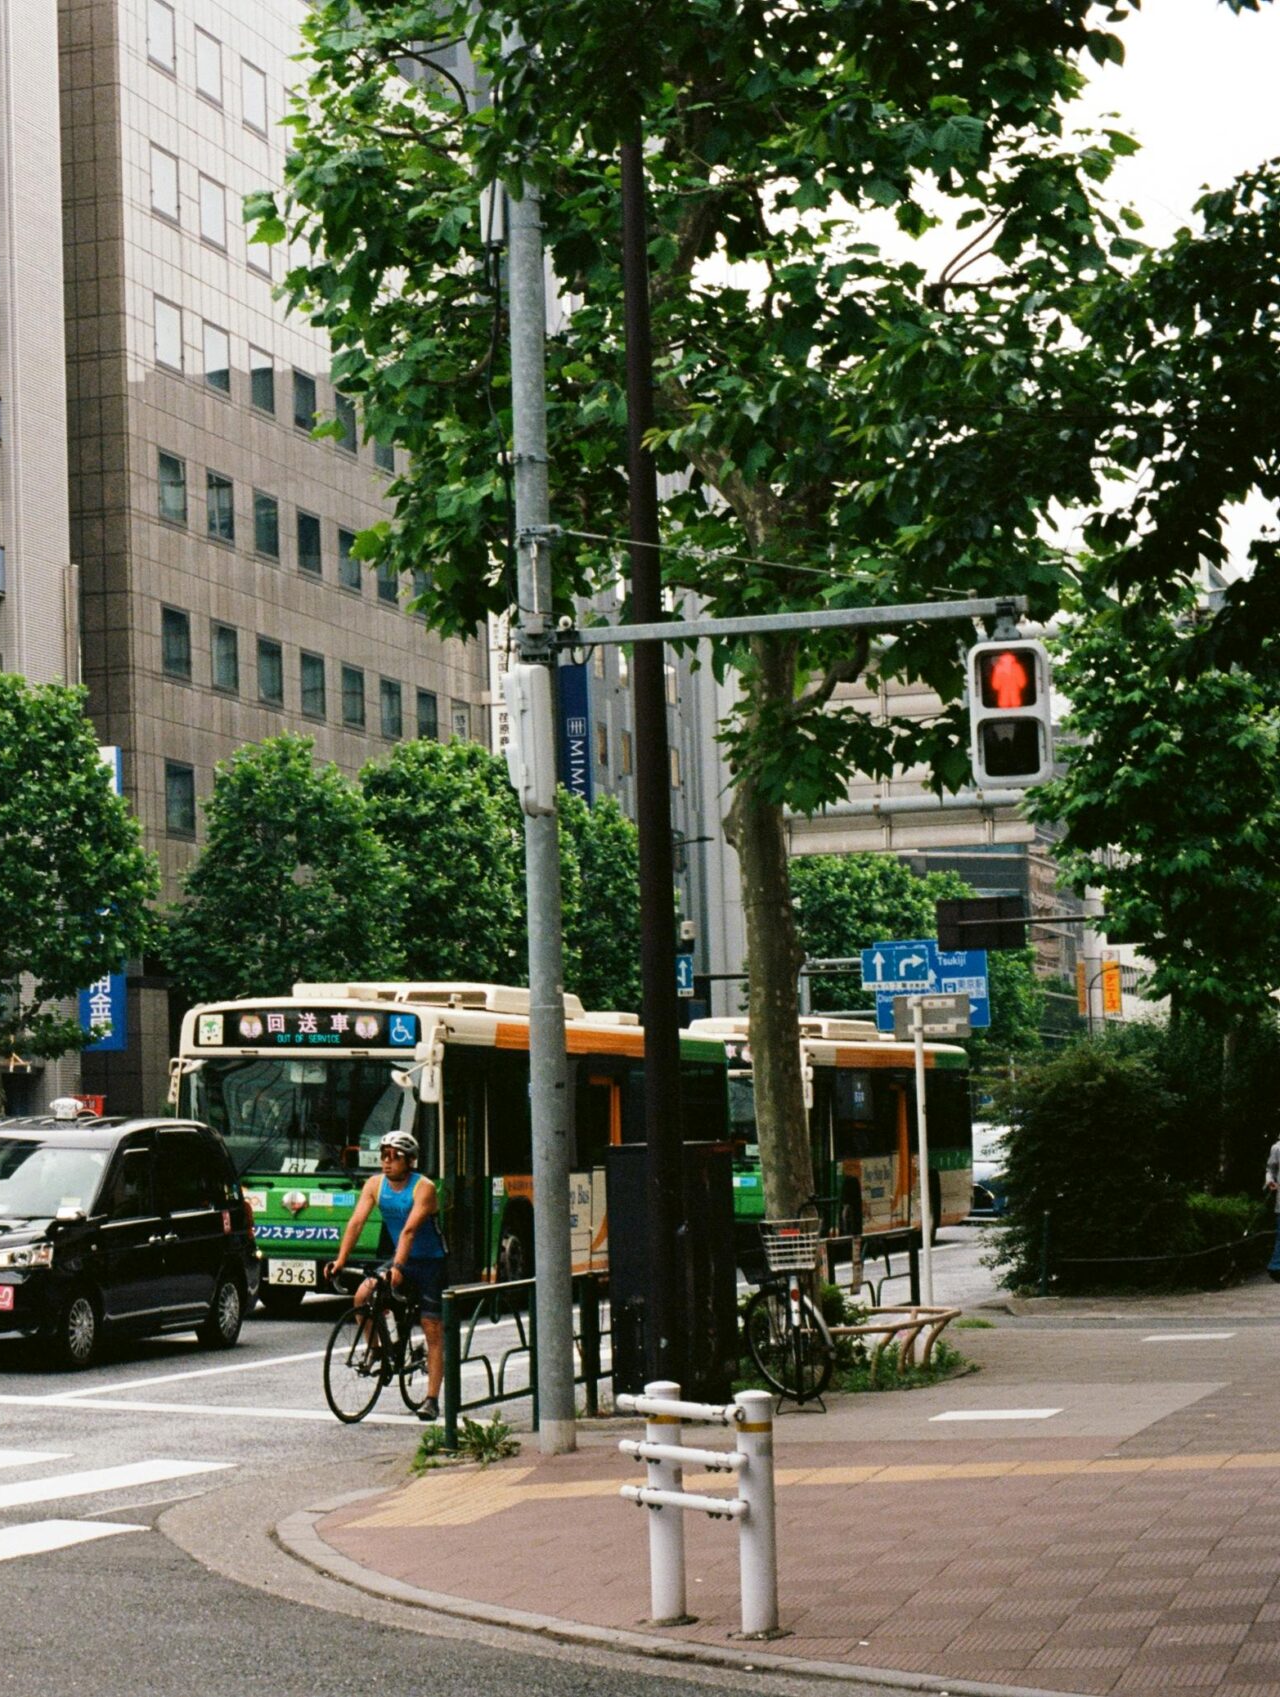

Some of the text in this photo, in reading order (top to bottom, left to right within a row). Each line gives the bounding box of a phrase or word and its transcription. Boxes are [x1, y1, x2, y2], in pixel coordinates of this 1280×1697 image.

[937, 956, 967, 968] Tsukiji
[267, 1012, 350, 1033] 回送車
[277, 1033, 341, 1044] OUT OF SERVICE
[276, 1267, 315, 1284] 29-63
